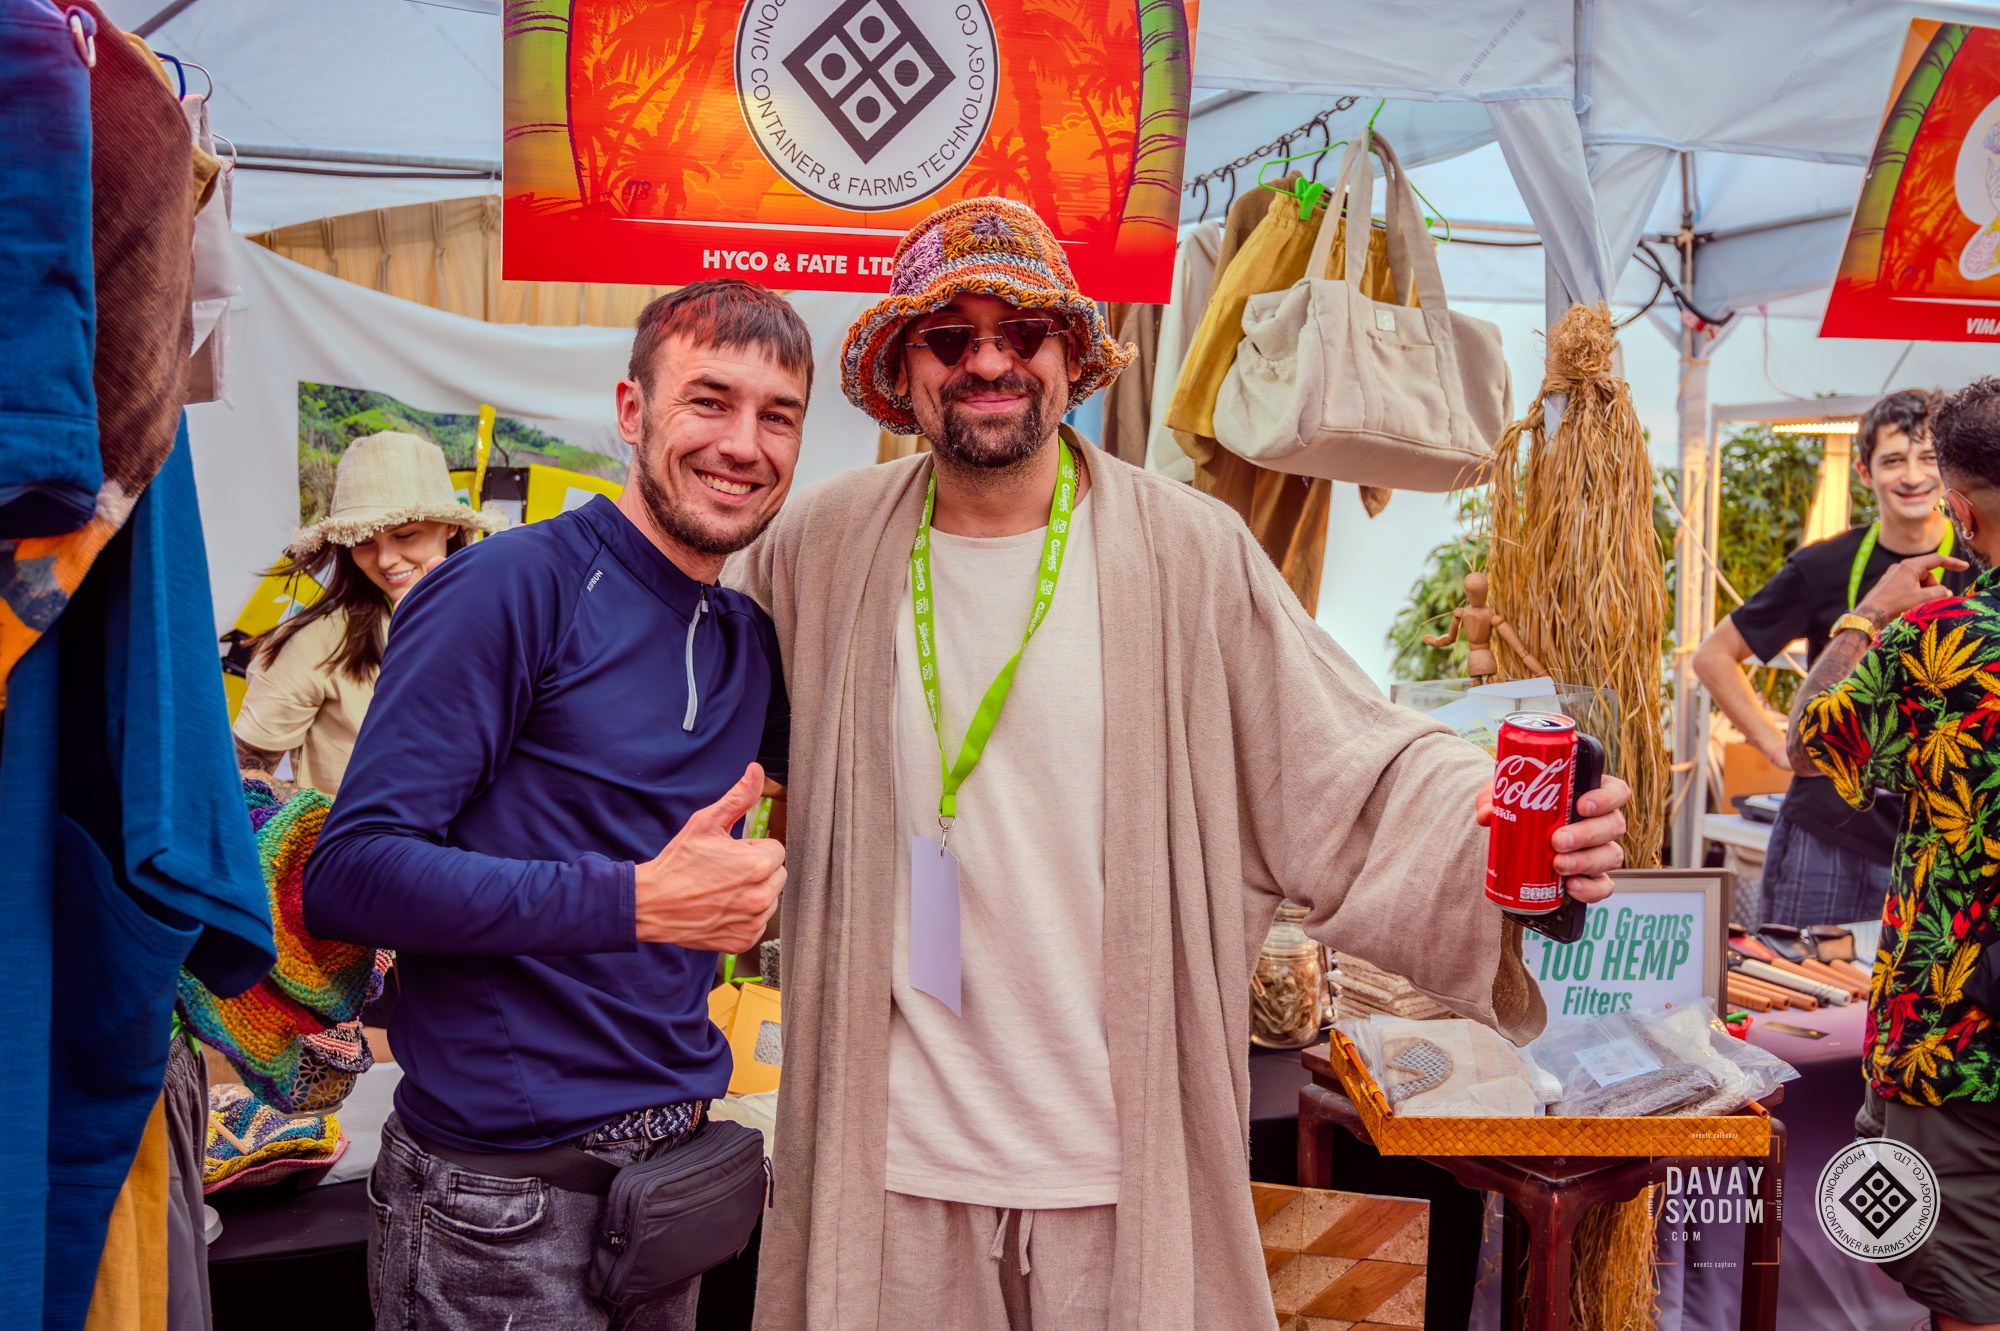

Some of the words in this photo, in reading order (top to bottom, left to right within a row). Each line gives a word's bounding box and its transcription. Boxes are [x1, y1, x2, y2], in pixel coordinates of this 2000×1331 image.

[751, 68, 826, 183] CONTAINER
[828, 172, 841, 191] &
[848, 170, 917, 197] FARMS
[917, 43, 985, 180] TECHNOLOGY
[702, 249, 769, 271] HYCO
[773, 252, 791, 272] &
[796, 253, 848, 275] FATE
[1614, 906, 1694, 942] Grams
[1539, 939, 1595, 981] 100
[1601, 939, 1690, 981] HEMP
[1562, 985, 1633, 1016] Filters
